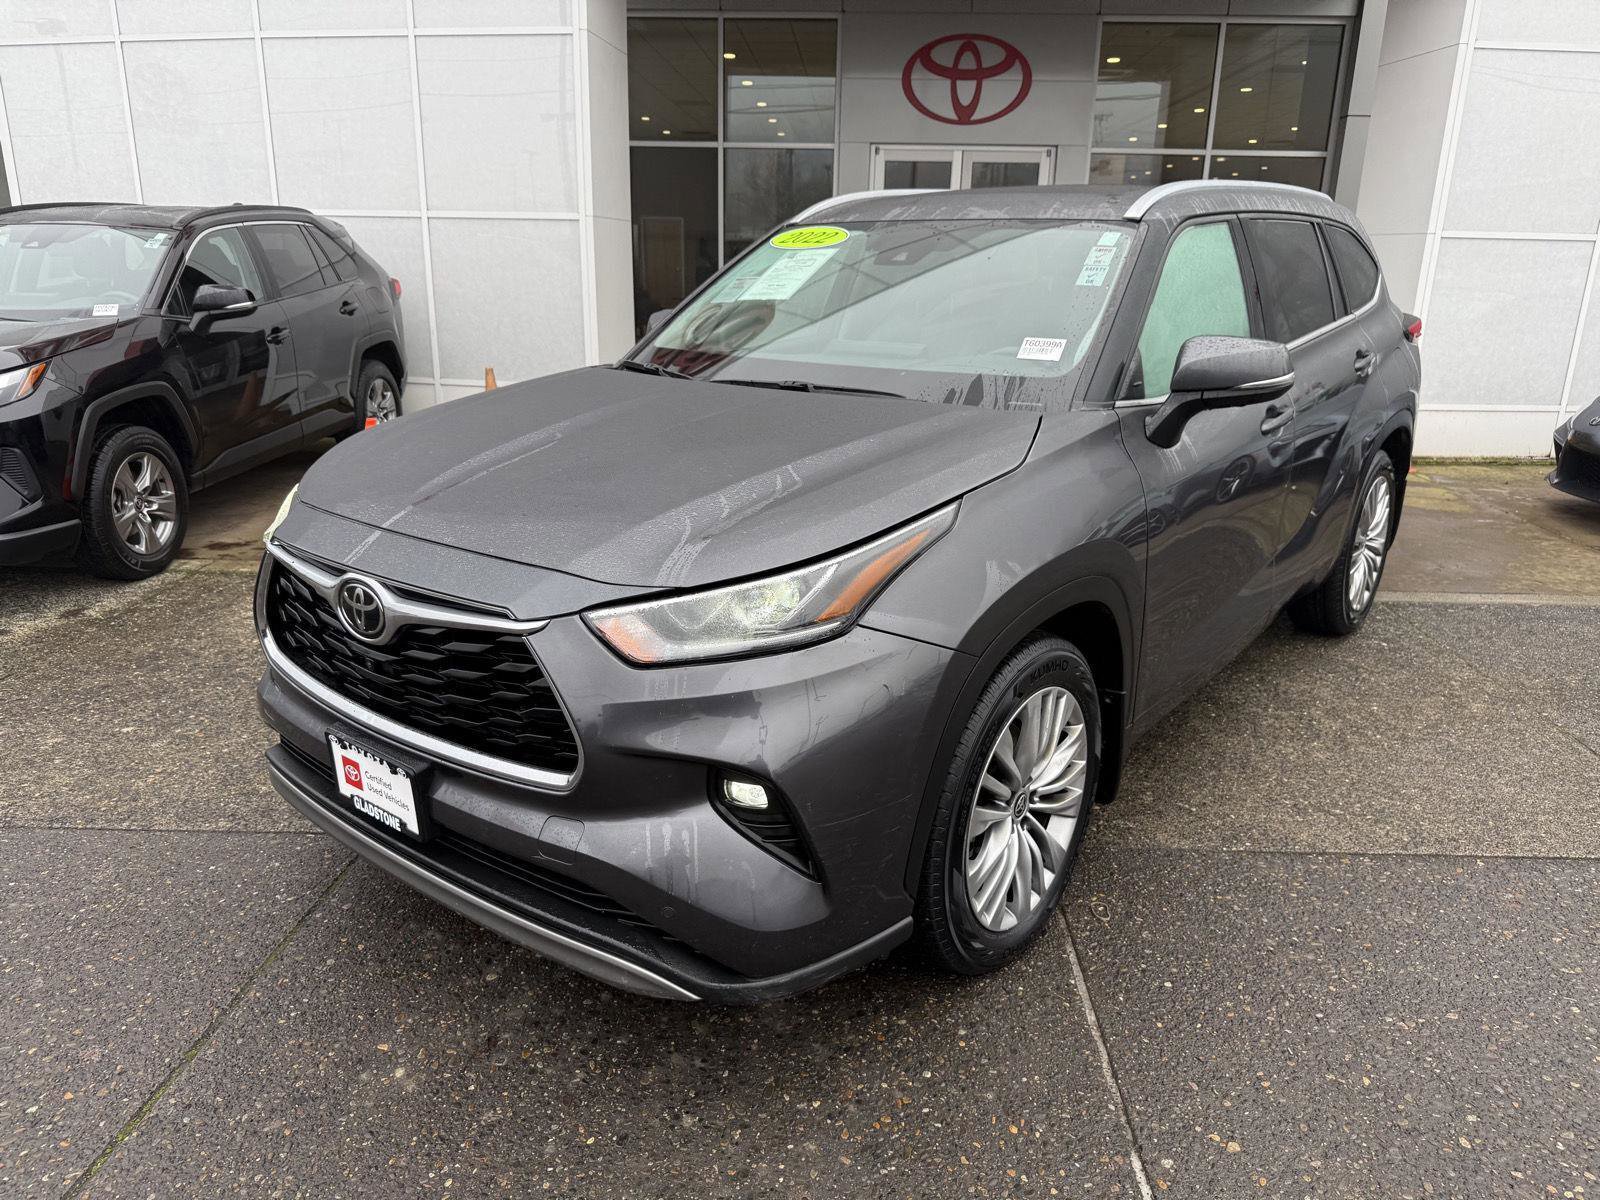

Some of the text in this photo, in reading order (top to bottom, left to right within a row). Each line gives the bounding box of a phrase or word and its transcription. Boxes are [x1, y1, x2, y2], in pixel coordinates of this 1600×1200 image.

[778, 231, 839, 244] 2022
[364, 771, 392, 791] Certified
[367, 783, 410, 812] Used Vehicles
[353, 796, 402, 832] GLADSTONE
